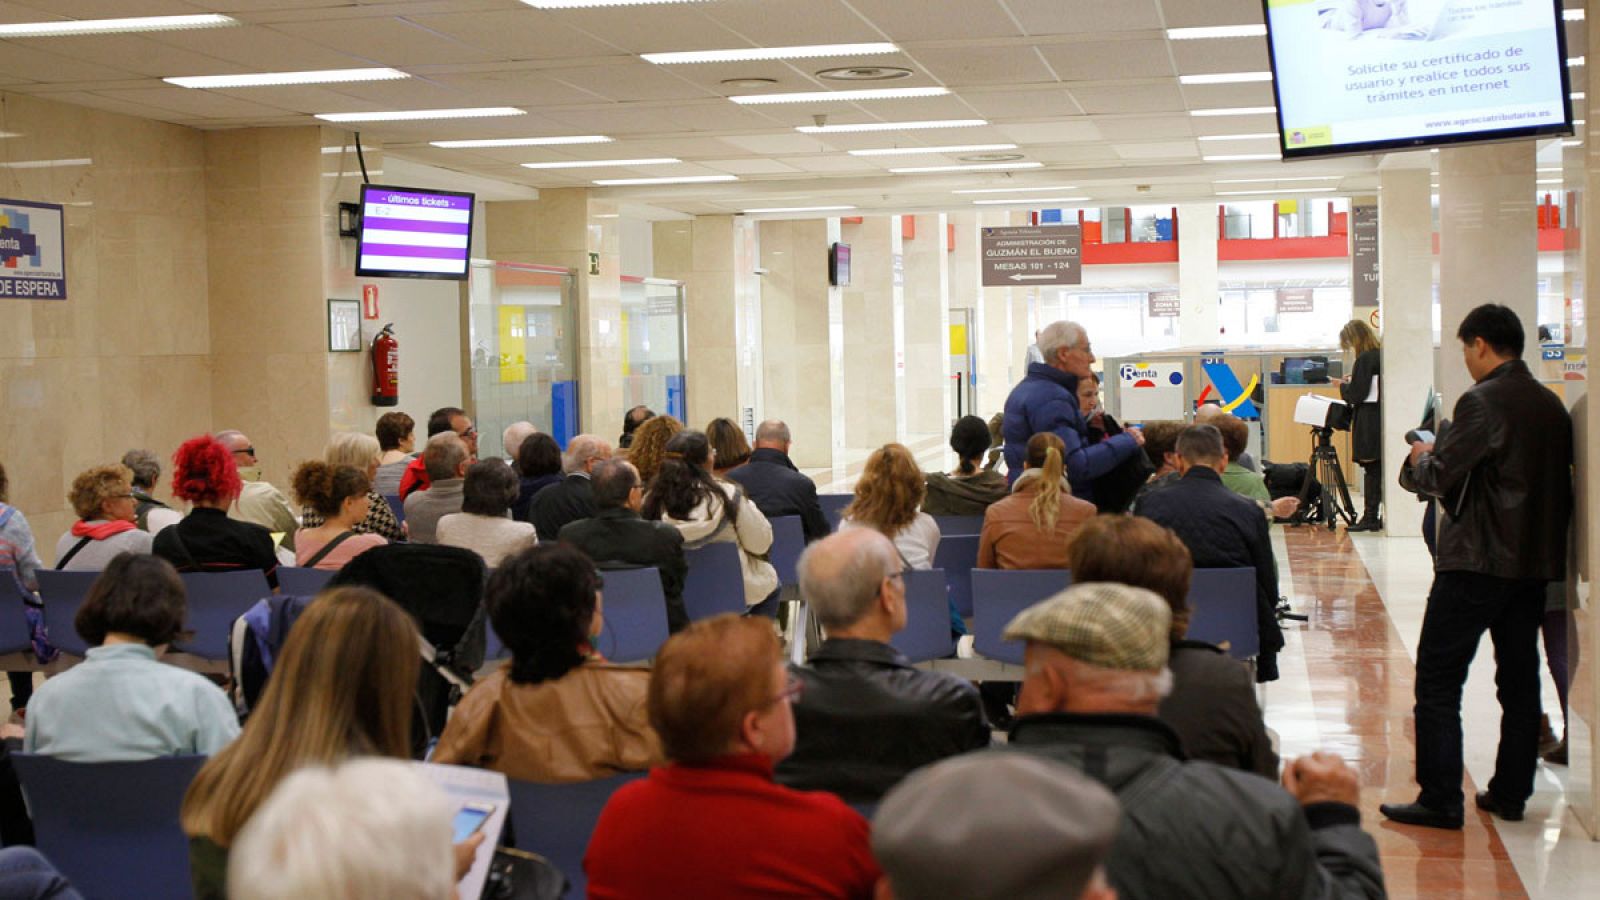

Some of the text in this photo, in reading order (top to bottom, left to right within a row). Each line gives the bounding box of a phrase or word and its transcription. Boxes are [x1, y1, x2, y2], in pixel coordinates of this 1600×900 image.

[1347, 46, 1524, 76] Solicite su certificado de
[1345, 62, 1531, 91] usuario y realice todos sus
[1366, 79, 1510, 104] trámites en internet
[1425, 110, 1551, 129] www.agenciatributaria.es
[387, 193, 420, 205] últimos
[421, 196, 449, 208] tickets
[986, 247, 1078, 257] GUZMÁN EL BUENO
[994, 262, 1027, 270] MESAS
[1030, 262, 1044, 270] 101
[1053, 261, 1070, 269] 124
[15, 280, 60, 296] ESPERA
[1121, 365, 1158, 381] Renta
